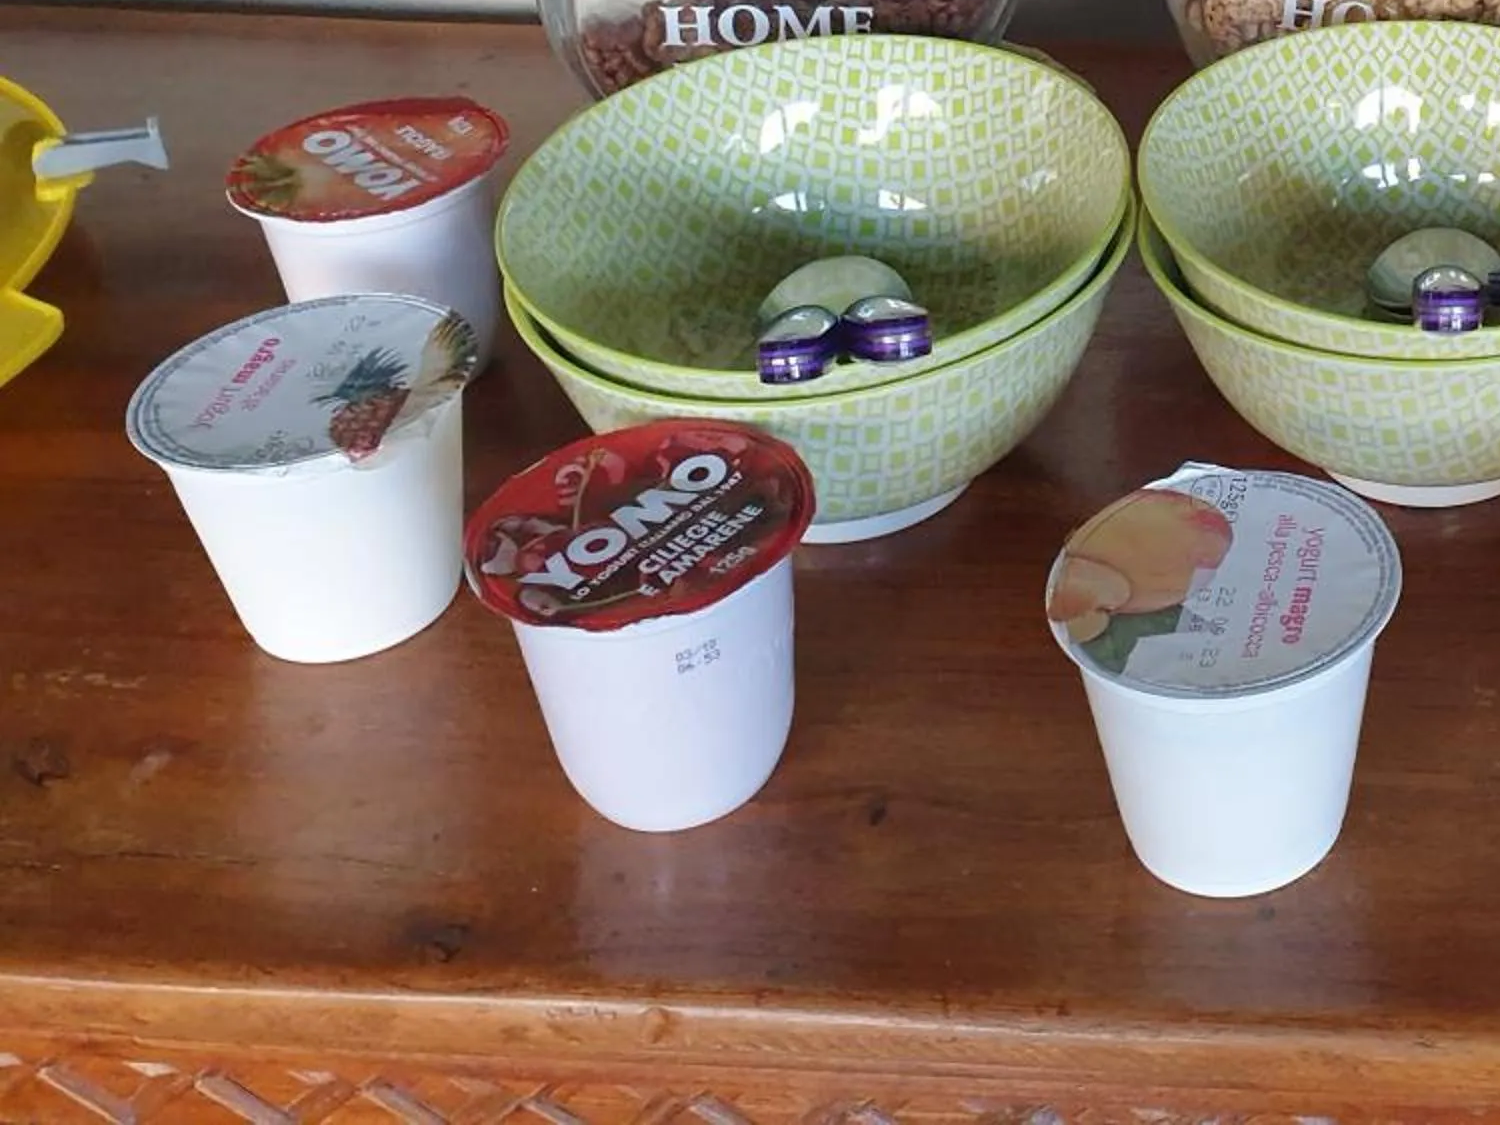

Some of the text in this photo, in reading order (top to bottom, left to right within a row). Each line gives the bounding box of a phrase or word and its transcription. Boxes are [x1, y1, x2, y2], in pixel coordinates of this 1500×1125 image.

[659, 4, 874, 47] HOME
[303, 129, 421, 201] YOMO
[232, 336, 281, 385] magro
[517, 453, 728, 591] YOMO
[638, 509, 732, 575] CILIEGIE
[638, 504, 764, 597] E AMARENE
[571, 584, 589, 601] LO
[586, 549, 640, 591] YOGURT
[709, 545, 758, 575] 125g
[1241, 513, 1297, 659] alla pesca-albicocca
[1279, 526, 1326, 645] yogurt magro
